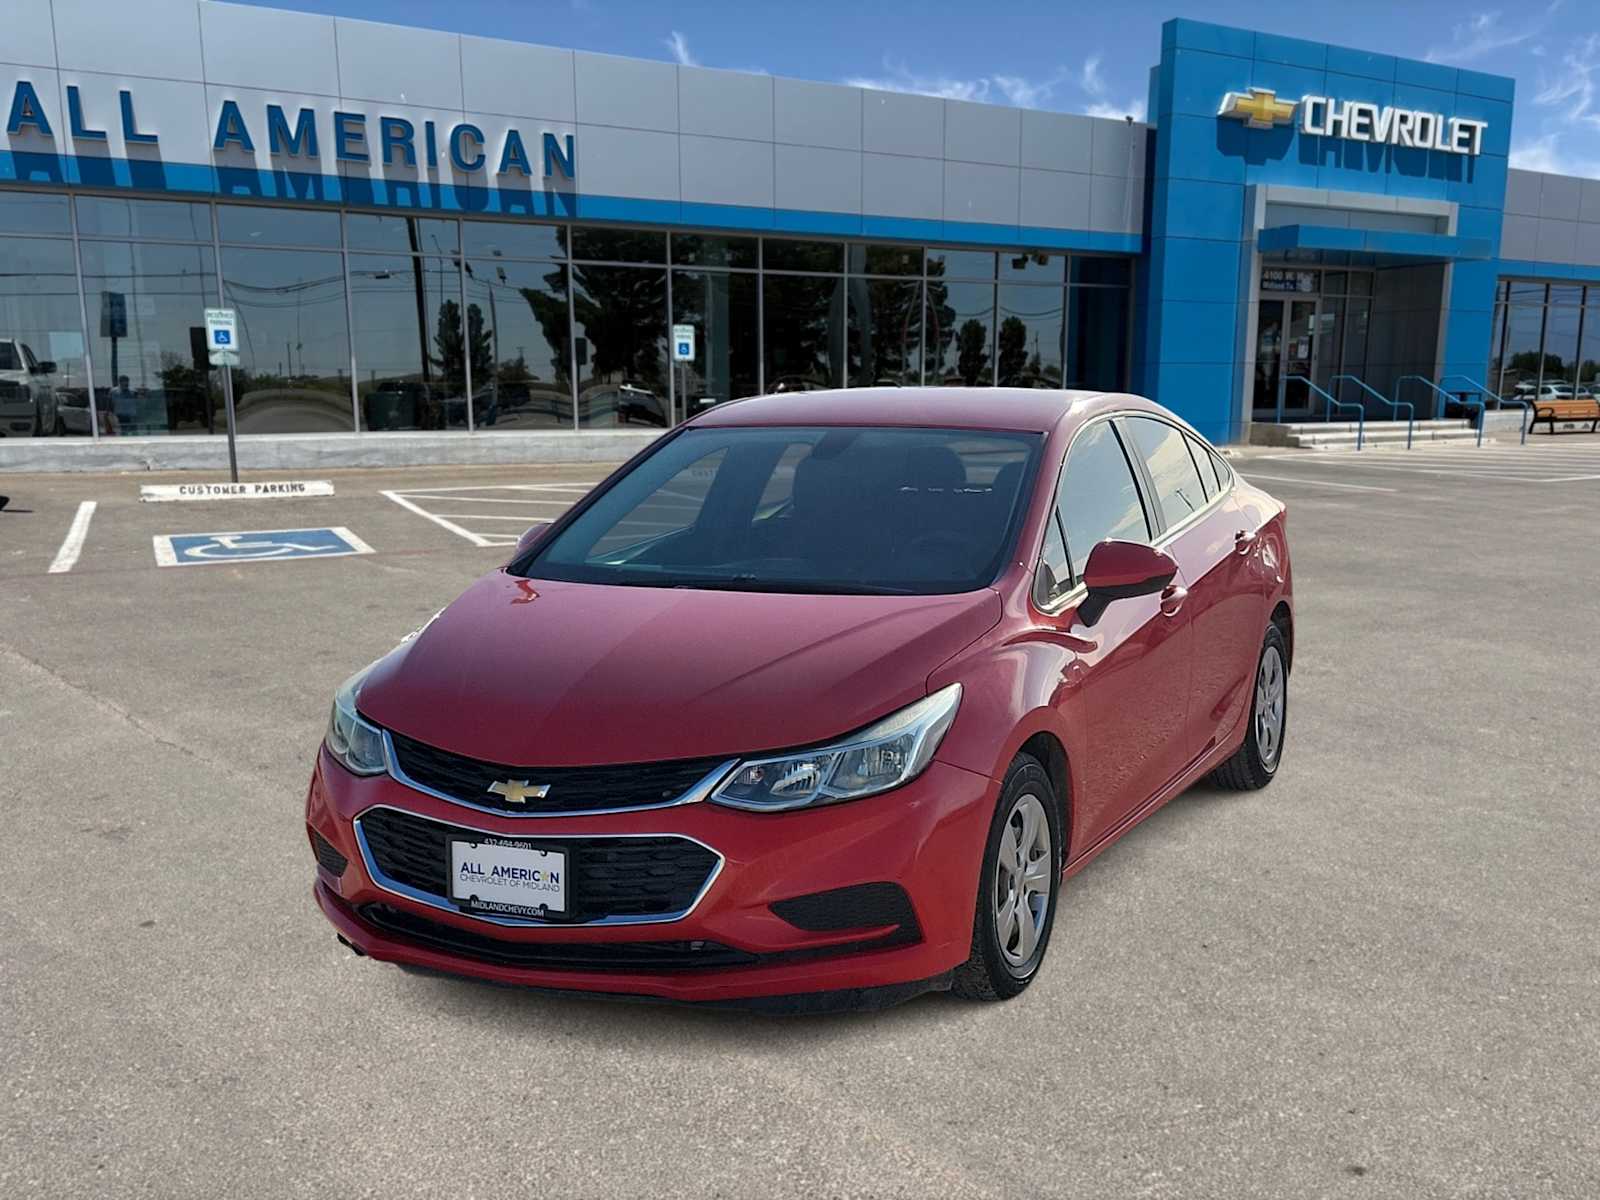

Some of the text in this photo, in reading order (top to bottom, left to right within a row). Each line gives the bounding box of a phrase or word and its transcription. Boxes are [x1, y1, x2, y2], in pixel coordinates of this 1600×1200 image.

[6, 80, 575, 179] ALL AMERICAN
[1301, 94, 1488, 155] CHEVROLET
[179, 482, 306, 495] CUSTOMER PARKING
[460, 862, 486, 876] ALL
[459, 873, 561, 893] CHEVROLET OF MIDLAND
[470, 900, 545, 917] MIDLANDCHEVY.COM
